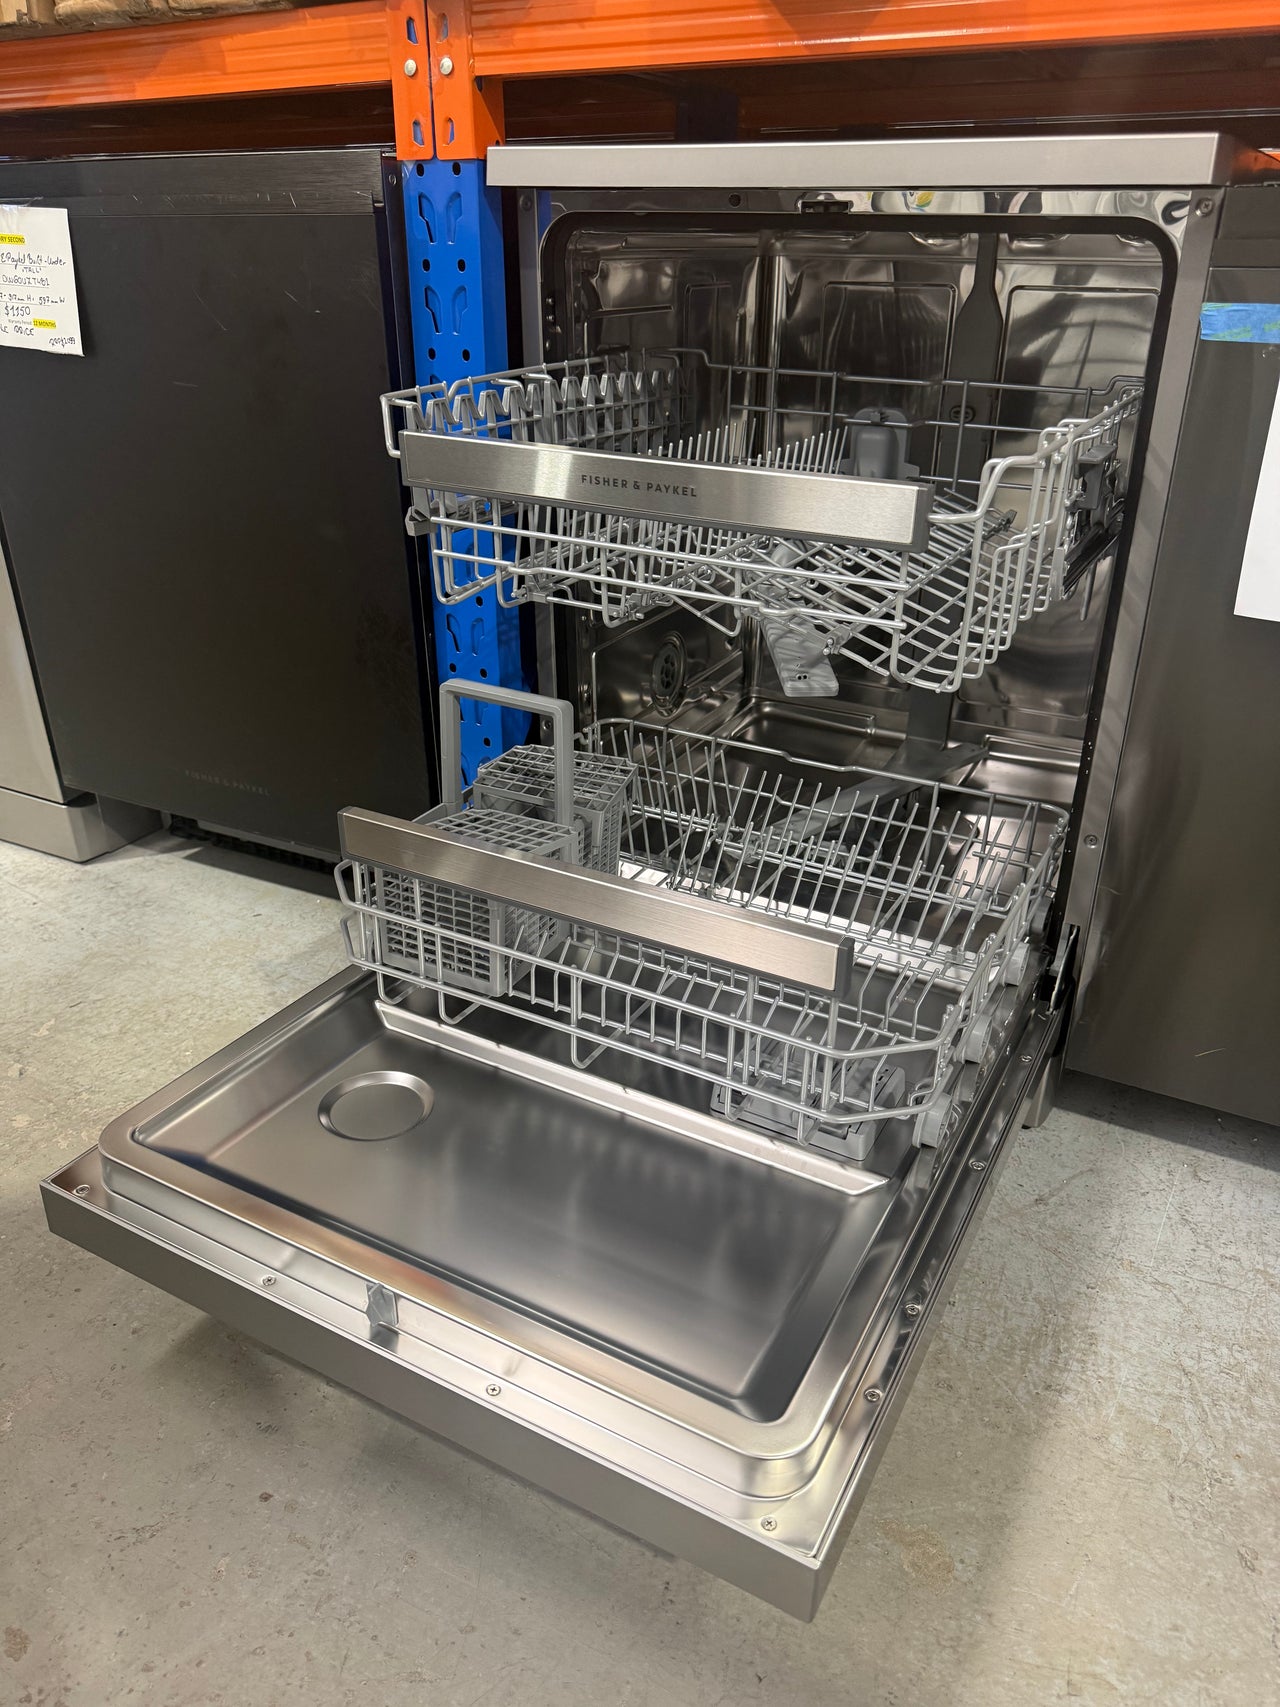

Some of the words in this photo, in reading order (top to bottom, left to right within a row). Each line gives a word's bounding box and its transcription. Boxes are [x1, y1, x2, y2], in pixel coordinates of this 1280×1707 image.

[7, 236, 26, 244] SECOND
[4, 302, 31, 317] $1150
[581, 474, 628, 489] FISHER
[632, 480, 640, 490] &
[646, 482, 697, 498] PAYKEL
